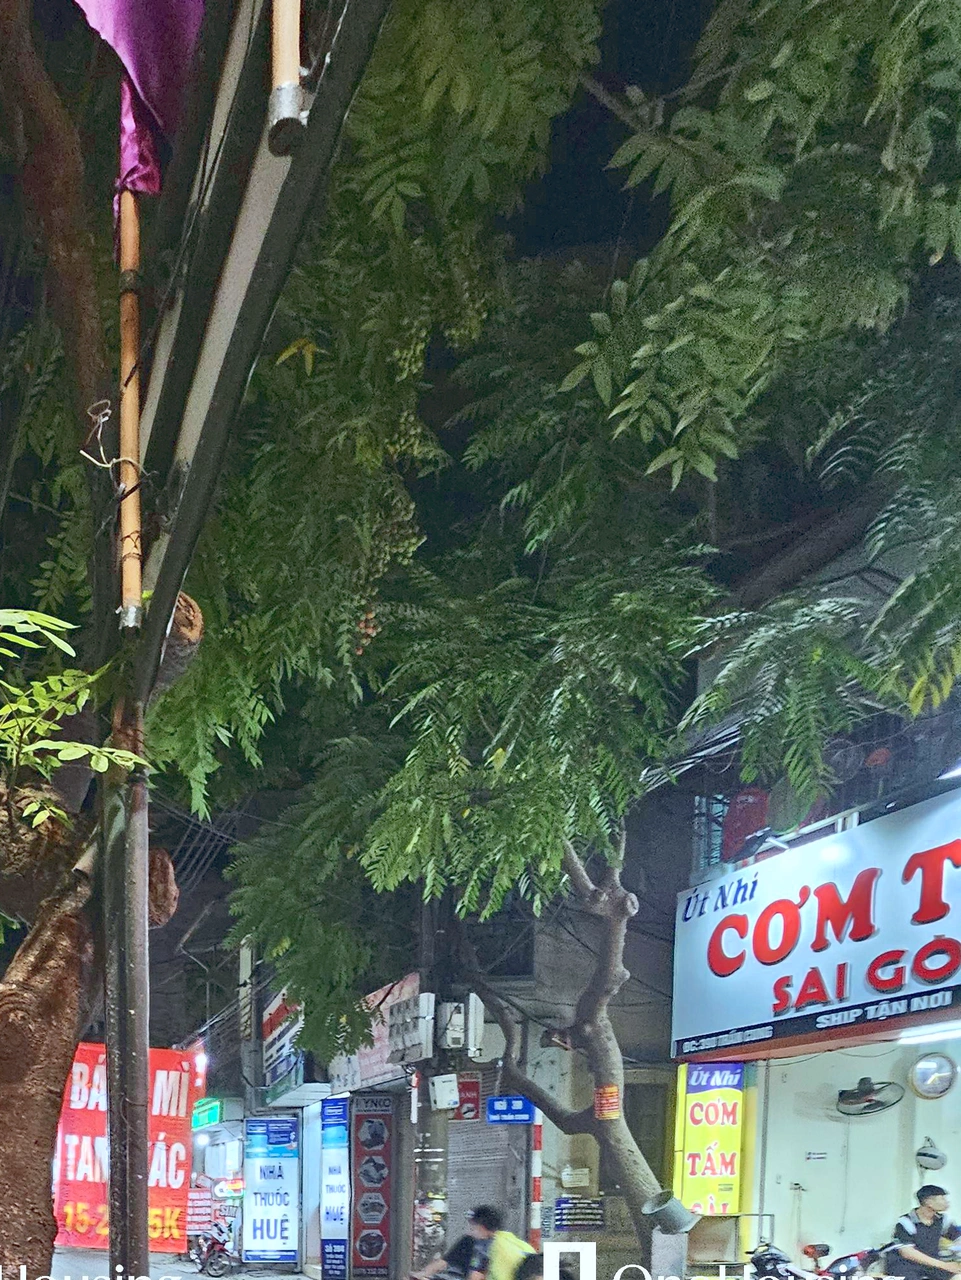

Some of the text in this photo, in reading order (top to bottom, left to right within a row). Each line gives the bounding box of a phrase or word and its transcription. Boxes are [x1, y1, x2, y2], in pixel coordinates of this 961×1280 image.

[683, 888, 708, 922] Út
[707, 867, 883, 978] CƠM
[815, 1007, 864, 1029] SHIP
[864, 1001, 908, 1021] TẬN
[69, 1054, 107, 1112] BÁ
[151, 1062, 190, 1118] MÌ
[689, 1066, 711, 1086] Út
[689, 1098, 739, 1126] CƠM
[148, 1131, 186, 1189] ÁC
[259, 1162, 284, 1180] NHÀ
[686, 1141, 737, 1177] TẤM
[253, 1186, 290, 1207] THUỐC
[252, 1214, 290, 1245] HUỆ
